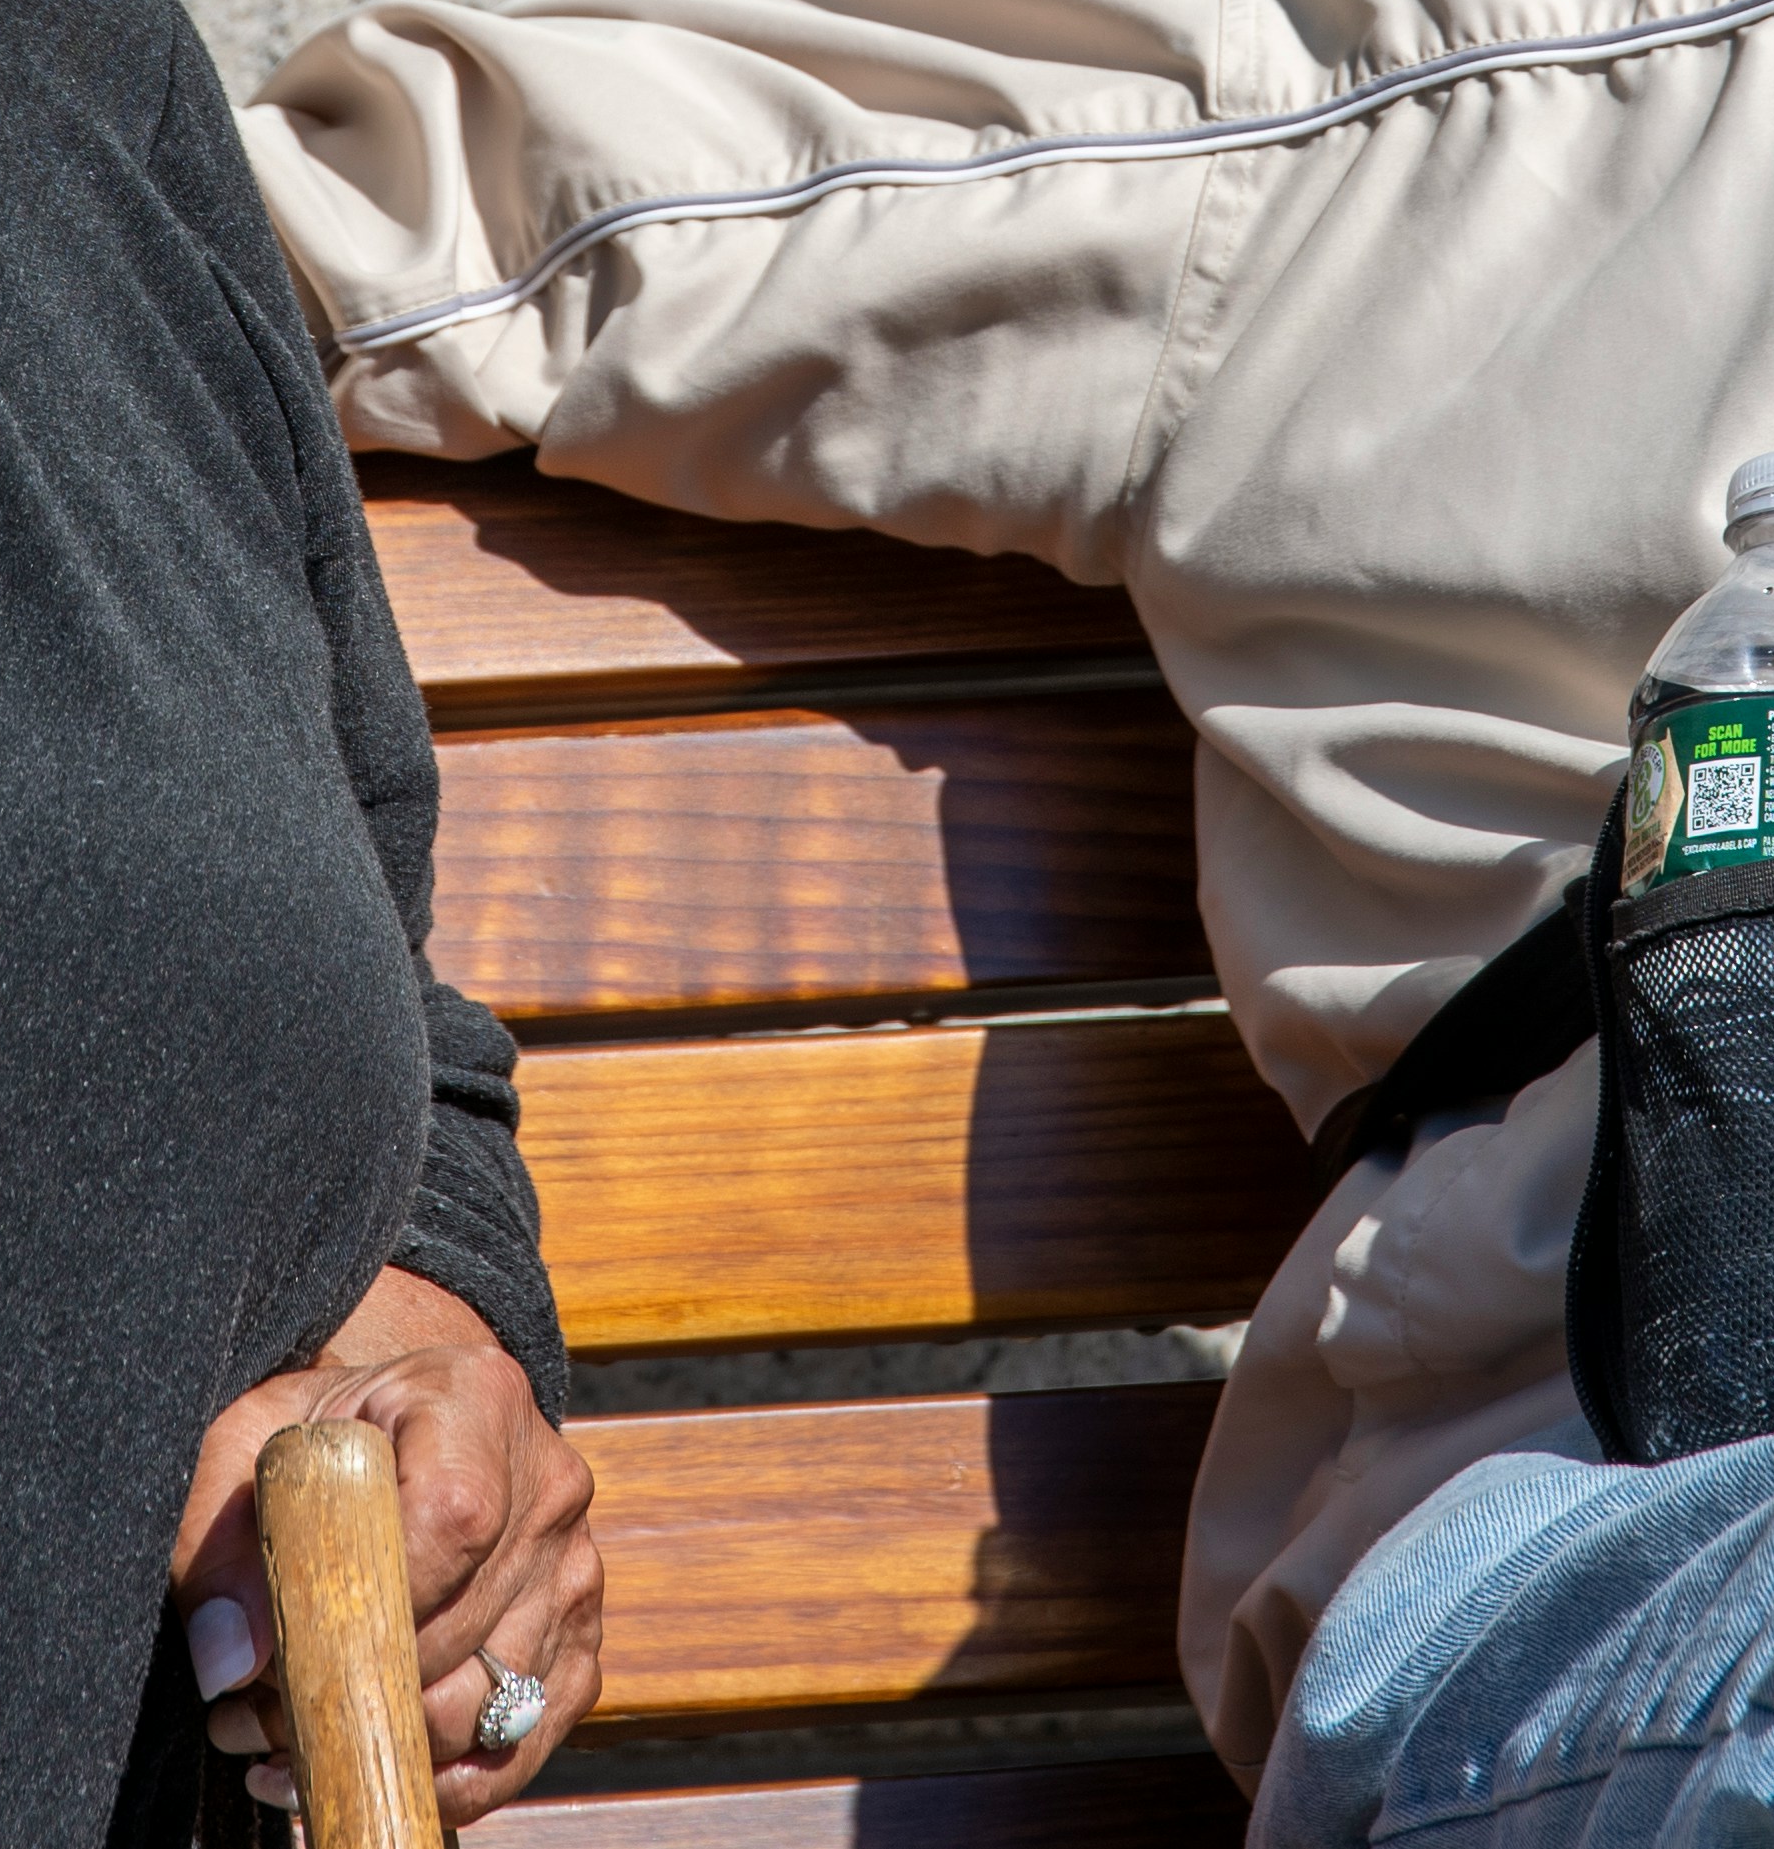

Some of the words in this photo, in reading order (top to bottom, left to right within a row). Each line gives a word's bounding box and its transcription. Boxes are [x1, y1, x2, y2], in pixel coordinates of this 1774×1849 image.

[1708, 723, 1743, 741] SCAN
[1694, 742, 1717, 760] FOR
[1720, 738, 1757, 755] MORE
[1717, 839, 1737, 851] LABEL
[1737, 839, 1743, 850] &
[1743, 838, 1758, 849] CAP
